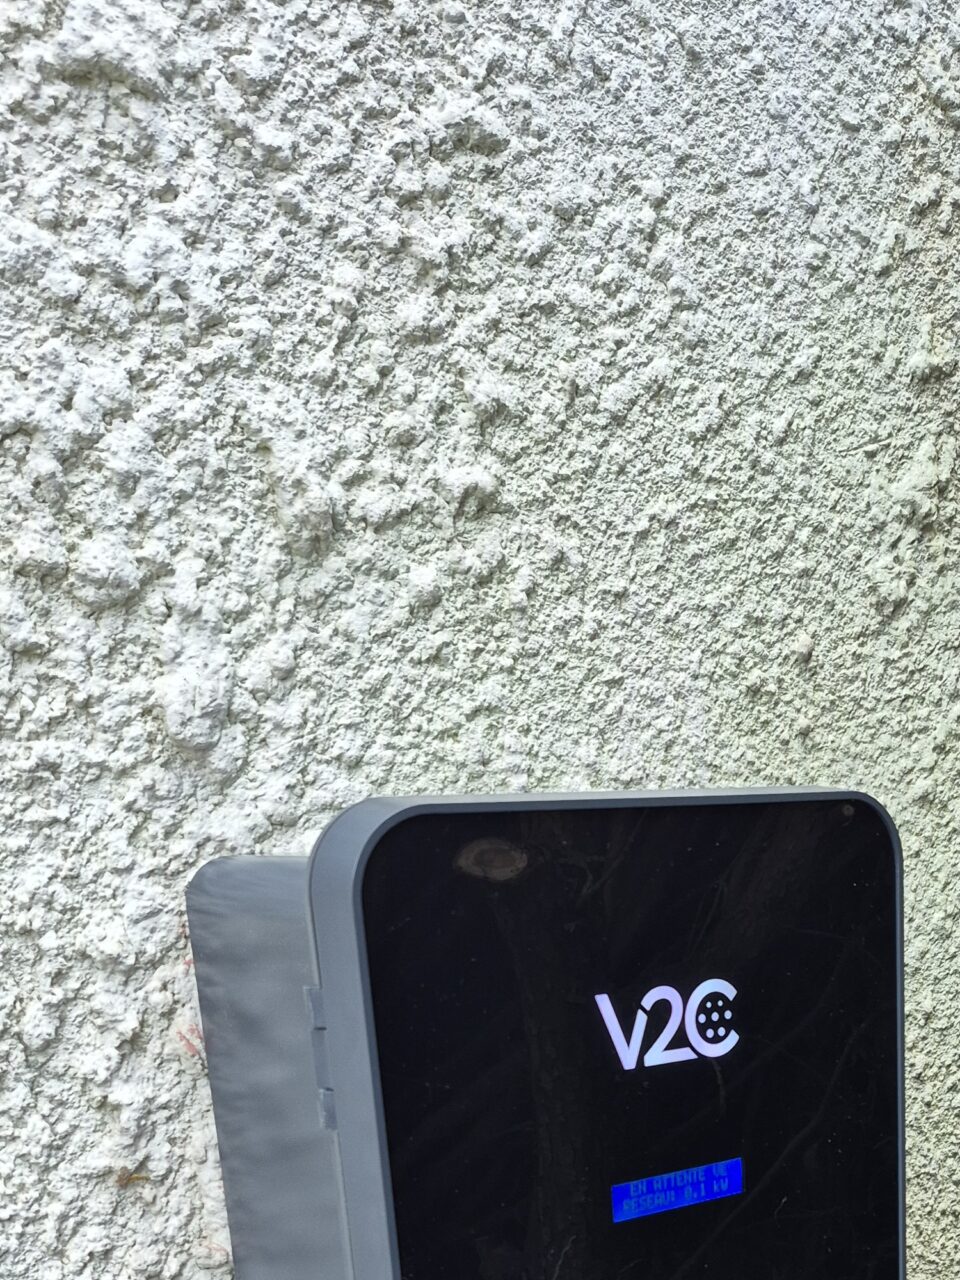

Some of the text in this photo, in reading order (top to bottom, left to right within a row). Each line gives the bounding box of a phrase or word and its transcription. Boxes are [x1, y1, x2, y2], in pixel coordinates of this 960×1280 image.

[595, 979, 739, 1070] V2C
[630, 1181, 647, 1197] EN
[653, 1168, 706, 1191] ATTENTE
[713, 1178, 729, 1193] kW
